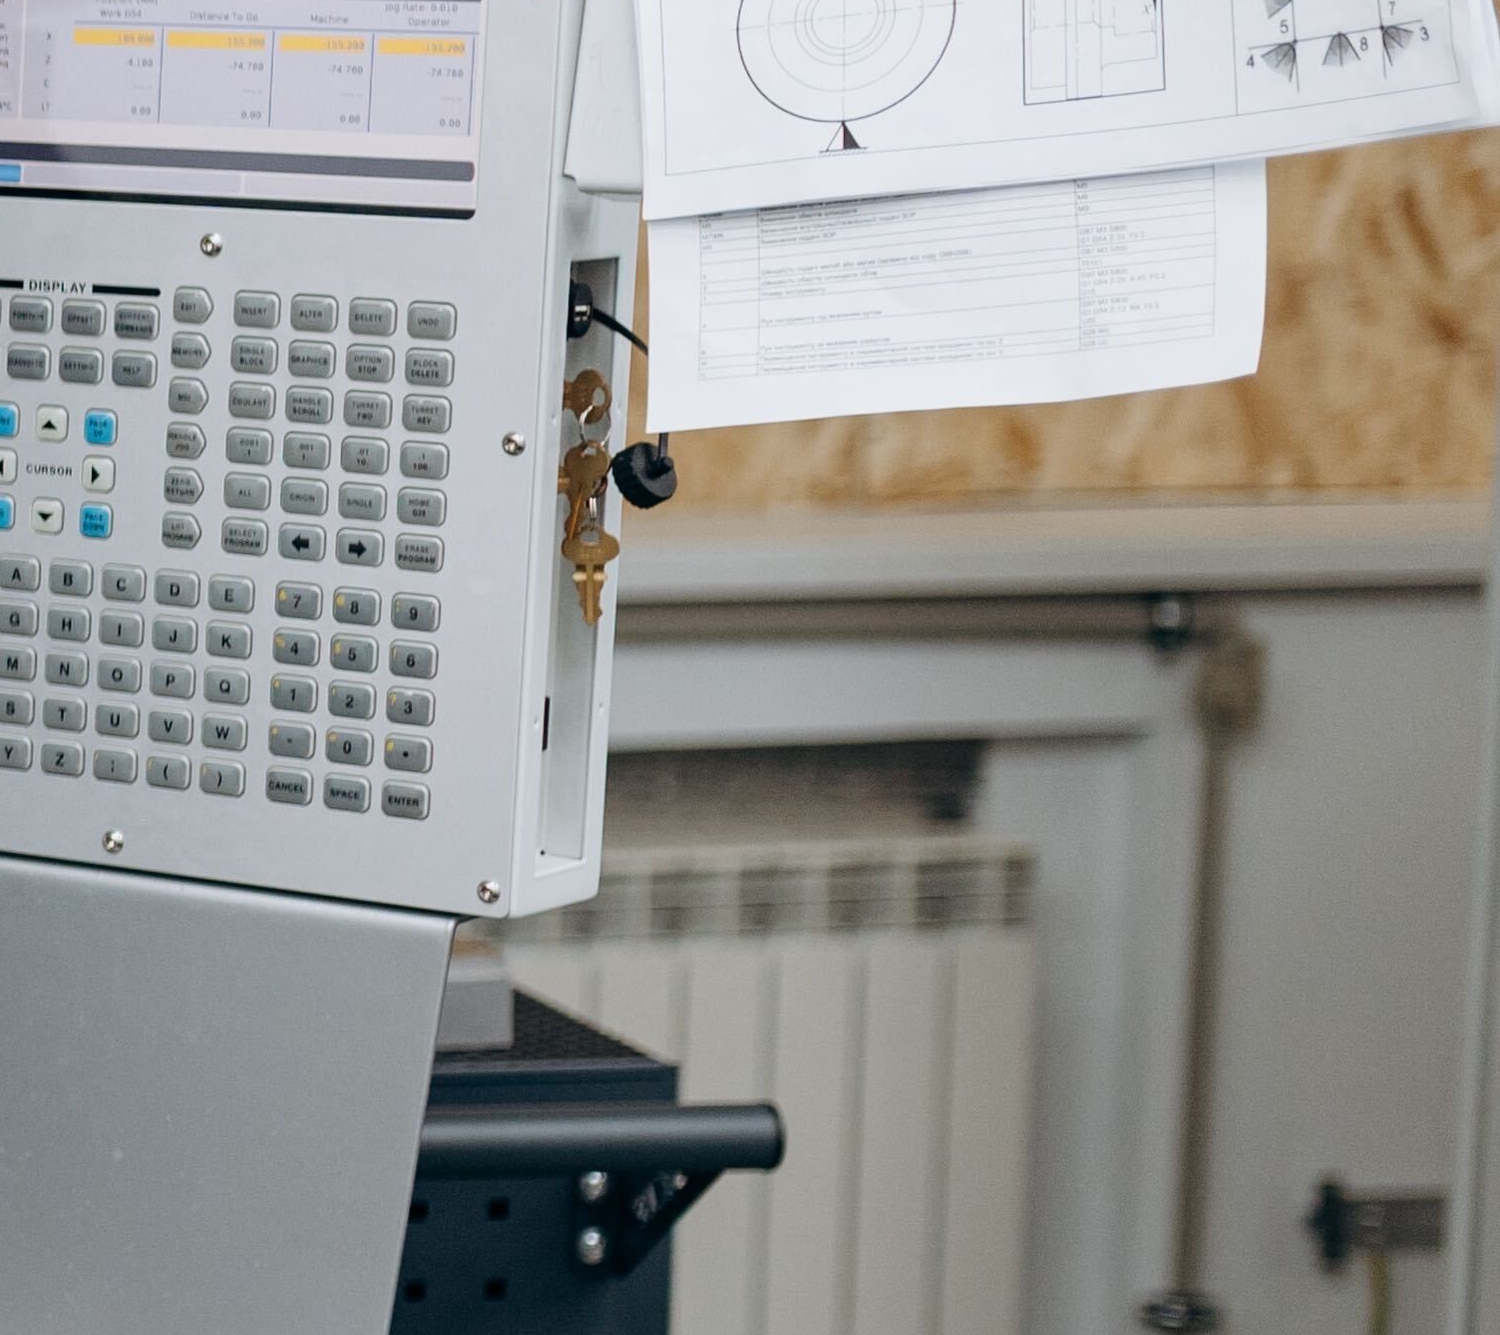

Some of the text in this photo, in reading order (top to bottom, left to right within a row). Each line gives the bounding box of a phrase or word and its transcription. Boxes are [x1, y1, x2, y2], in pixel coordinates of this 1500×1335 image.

[1388, 1, 1396, 15] 7
[310, 14, 349, 25] Machine
[408, 17, 450, 27] Operator
[1280, 19, 1289, 33] 5
[1420, 26, 1429, 41] 3
[1360, 37, 1368, 51] 8
[1246, 55, 1255, 68] 4
[29, 279, 86, 294] DISPLAY
[180, 303, 197, 312] EDIT
[241, 307, 268, 315] INSERT
[300, 310, 323, 319] ALTER
[354, 313, 383, 323] DELETE
[418, 318, 439, 327] UNDO
[240, 357, 264, 366] BLOCK
[291, 356, 328, 366] GRAPHICS
[354, 355, 382, 365] OPTION
[413, 359, 439, 368] BLOCK
[358, 365, 378, 374] STOP
[411, 369, 440, 379] DELETE
[232, 397, 268, 408] COOLANT
[352, 401, 380, 411] TURRET
[292, 407, 321, 417] SCROLL
[411, 405, 439, 415] TURRET
[416, 416, 432, 425] REV
[26, 463, 73, 477] CURSOR
[238, 488, 252, 497] ALL
[289, 493, 316, 503] ORIGIN
[347, 498, 372, 509] SINGLE
[408, 498, 430, 508] HOME
[224, 537, 261, 548] PROGRAM
[398, 553, 436, 564] PROGRAM
[11, 568, 22, 582] A
[63, 573, 73, 587] B
[116, 578, 127, 592] C
[169, 583, 180, 597] D
[224, 588, 233, 603] E
[294, 595, 301, 608] 7
[350, 601, 359, 615] 8
[409, 607, 418, 621] 9
[9, 613, 20, 627] G
[61, 619, 72, 632] H
[117, 623, 122, 637] I
[169, 630, 177, 643] J
[221, 634, 232, 649] K
[290, 642, 299, 656] 4
[348, 648, 356, 661] 5
[7, 657, 19, 671] M
[407, 654, 415, 668] 6
[60, 663, 70, 677] N
[111, 668, 123, 682] O
[166, 674, 175, 687] P
[219, 680, 231, 694] Q
[290, 689, 295, 702] 1
[345, 695, 354, 709] 2
[6, 702, 16, 715] S
[58, 708, 67, 721] T
[404, 701, 412, 715] 3
[110, 714, 120, 728] U
[164, 720, 173, 734] V
[216, 726, 230, 740] W
[4, 746, 14, 759] Y
[343, 741, 351, 755] 0
[55, 753, 65, 766] Z
[268, 780, 304, 793] CANCEL
[330, 787, 360, 800] SPACE
[387, 795, 419, 807] ENTER
